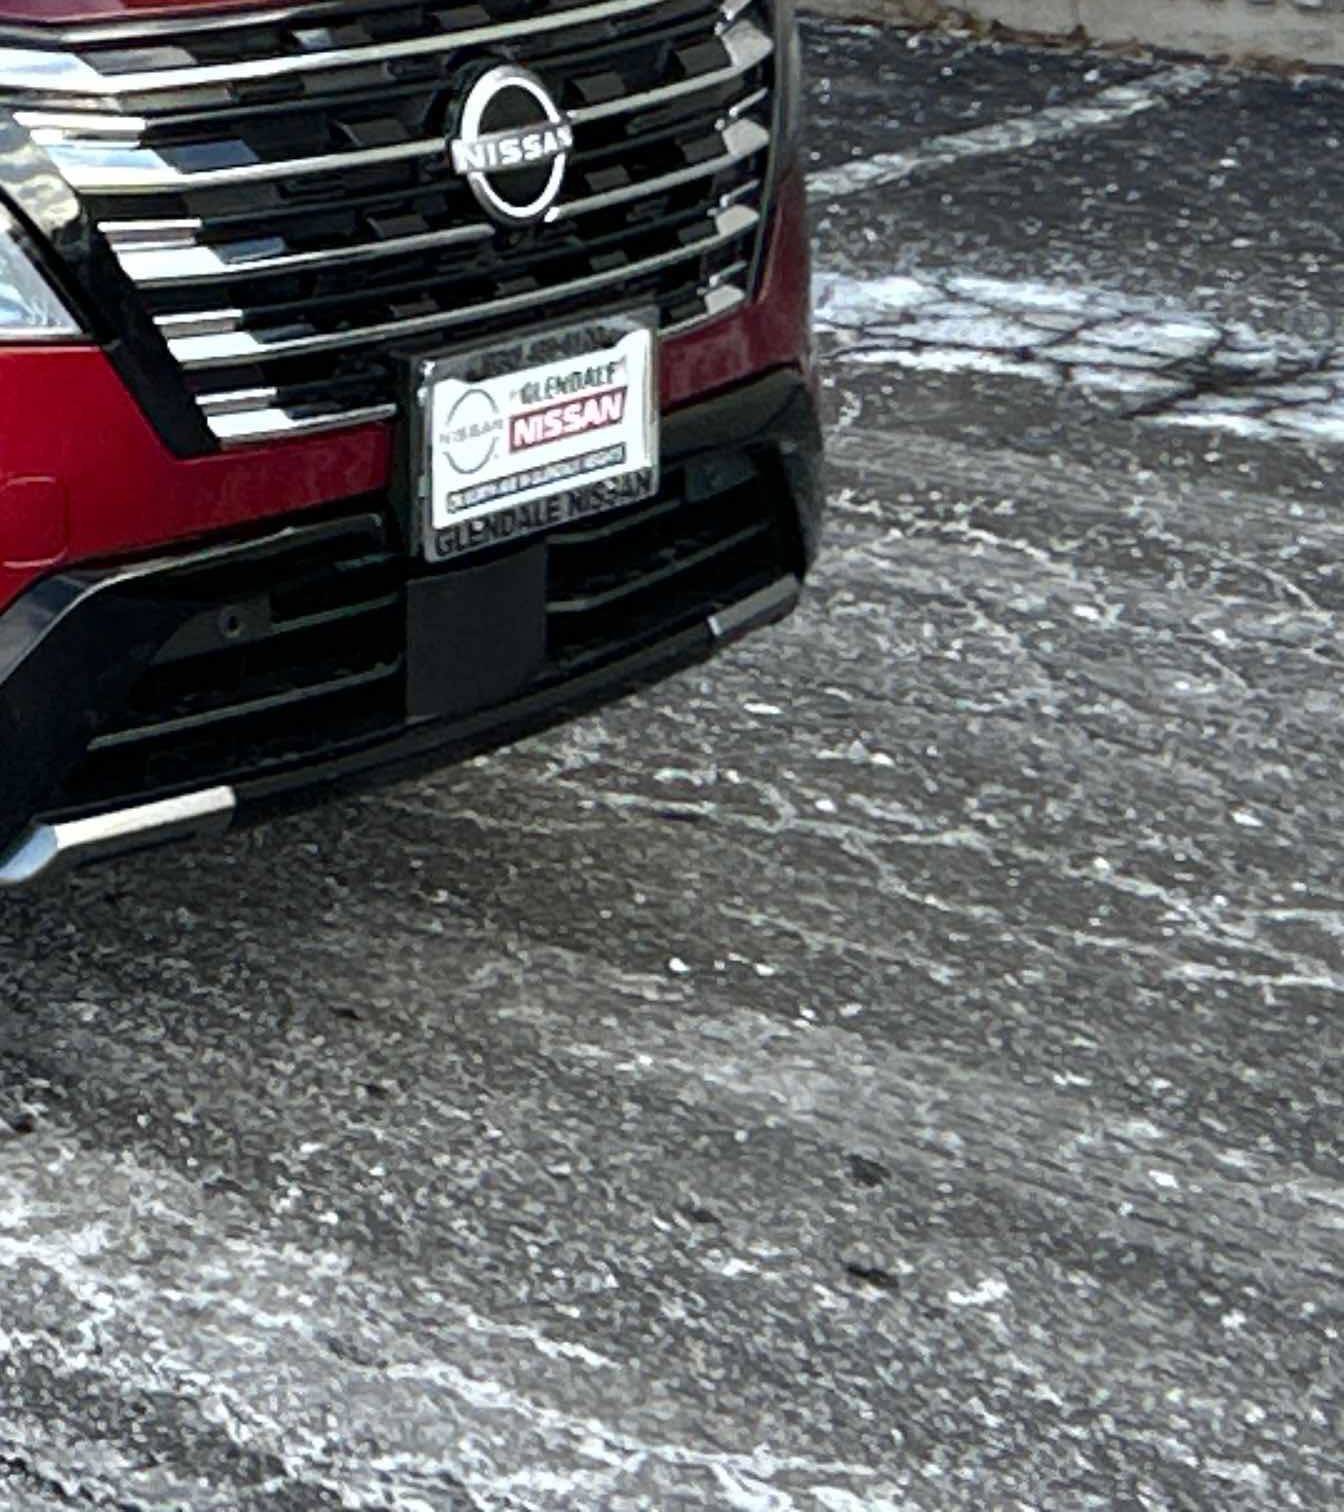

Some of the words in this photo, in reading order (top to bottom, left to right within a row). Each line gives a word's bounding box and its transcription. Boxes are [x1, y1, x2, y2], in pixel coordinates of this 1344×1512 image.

[451, 124, 573, 175] NISSAN
[519, 360, 616, 405] GLENDALE
[438, 418, 504, 445] NISSAN
[512, 390, 625, 447] NISSAN
[433, 495, 562, 557] GLENDALE
[565, 468, 653, 515] NISSAN
